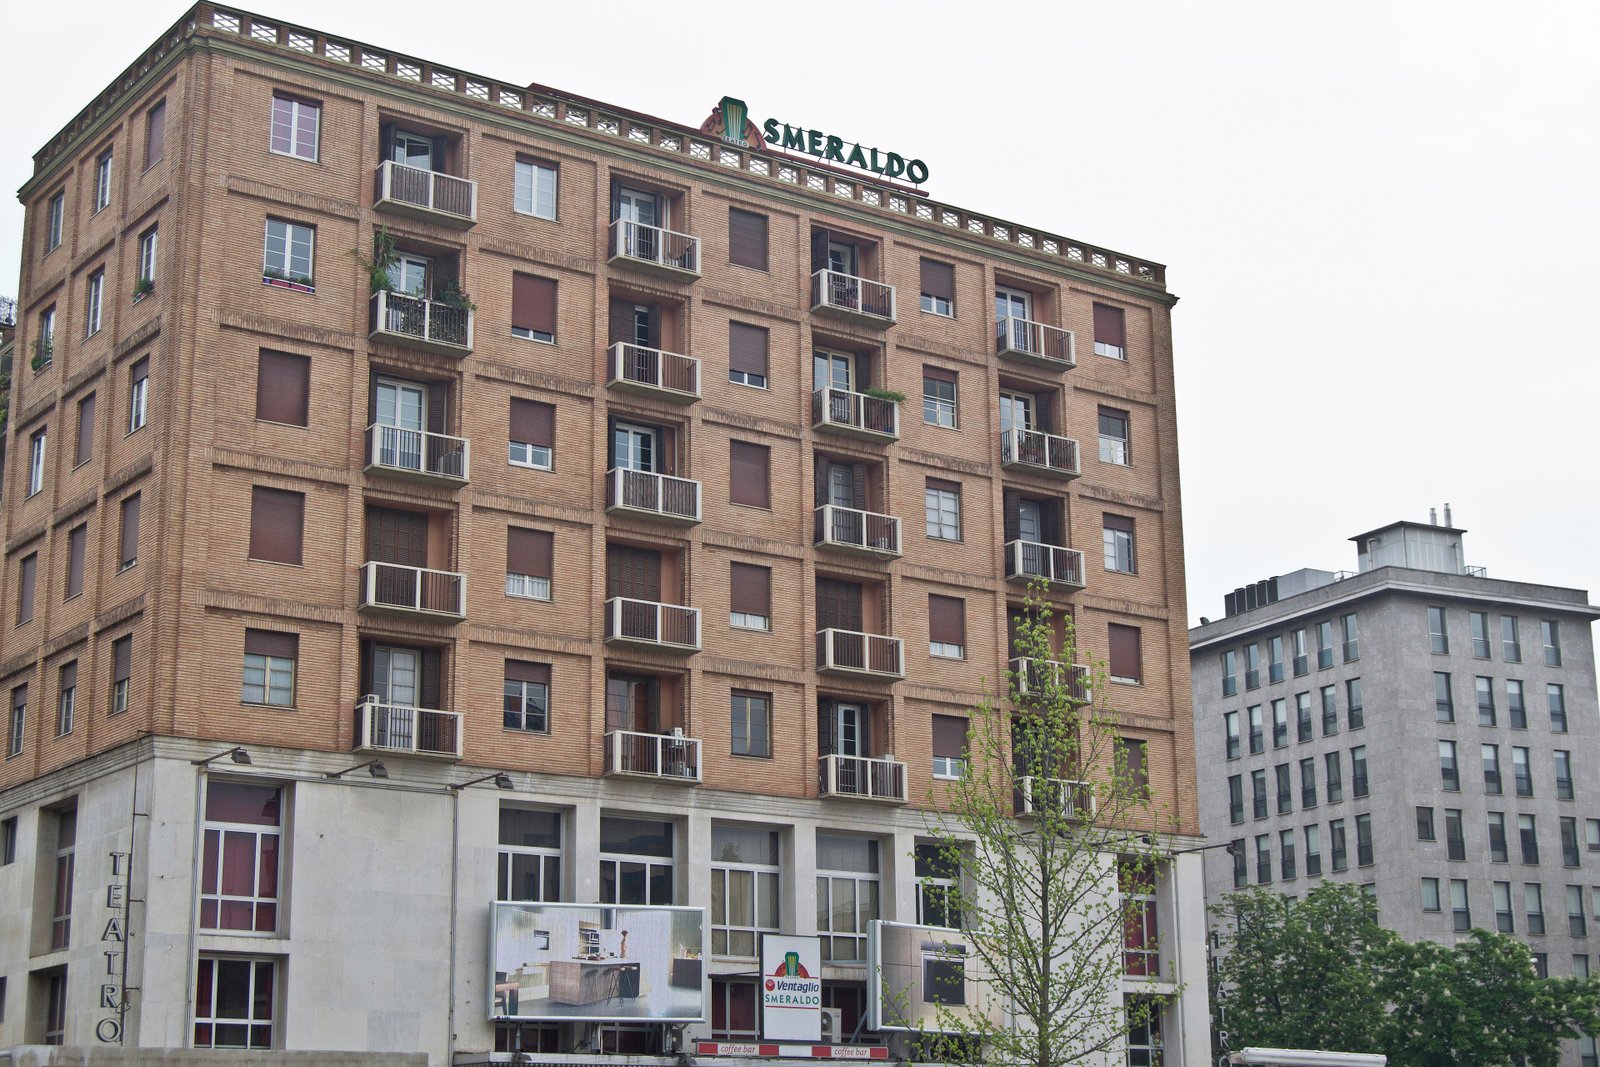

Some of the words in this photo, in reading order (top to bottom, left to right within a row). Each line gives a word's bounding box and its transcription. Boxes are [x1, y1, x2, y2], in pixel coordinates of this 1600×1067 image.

[722, 136, 748, 147] TEATRO
[764, 118, 929, 184] SMERALDO
[96, 852, 125, 1042] TEATRO
[777, 981, 819, 994] Ventaglio
[765, 993, 820, 1005] SMERALDO
[720, 1045, 742, 1054] coffee
[743, 1045, 756, 1054] bar
[834, 1048, 854, 1058] coffee
[856, 1049, 867, 1057] bar
